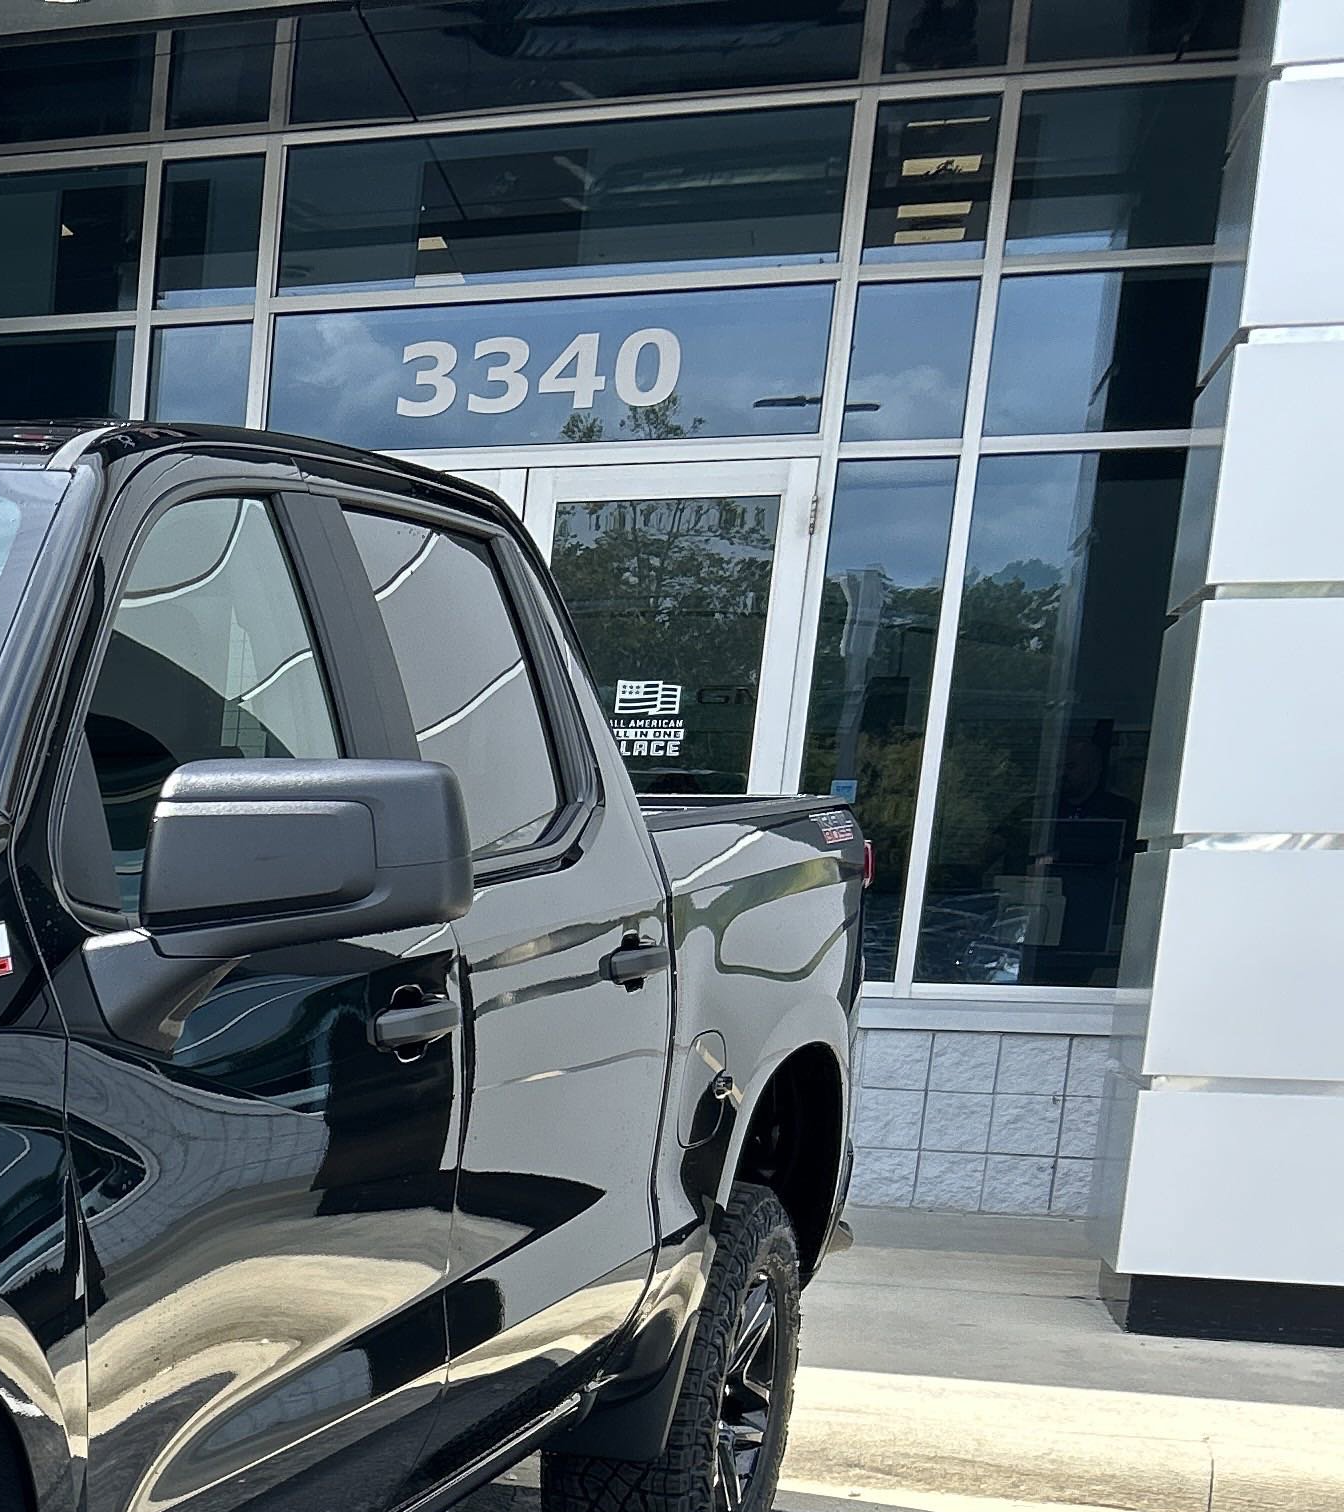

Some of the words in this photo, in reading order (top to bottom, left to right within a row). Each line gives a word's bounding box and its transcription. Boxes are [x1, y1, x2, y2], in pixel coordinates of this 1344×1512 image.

[396, 326, 682, 418] 3340
[628, 719, 684, 728] AMERICAN
[616, 730, 630, 739] LL
[634, 730, 649, 739] IN
[652, 730, 682, 739] ONE
[620, 740, 681, 757] LACE
